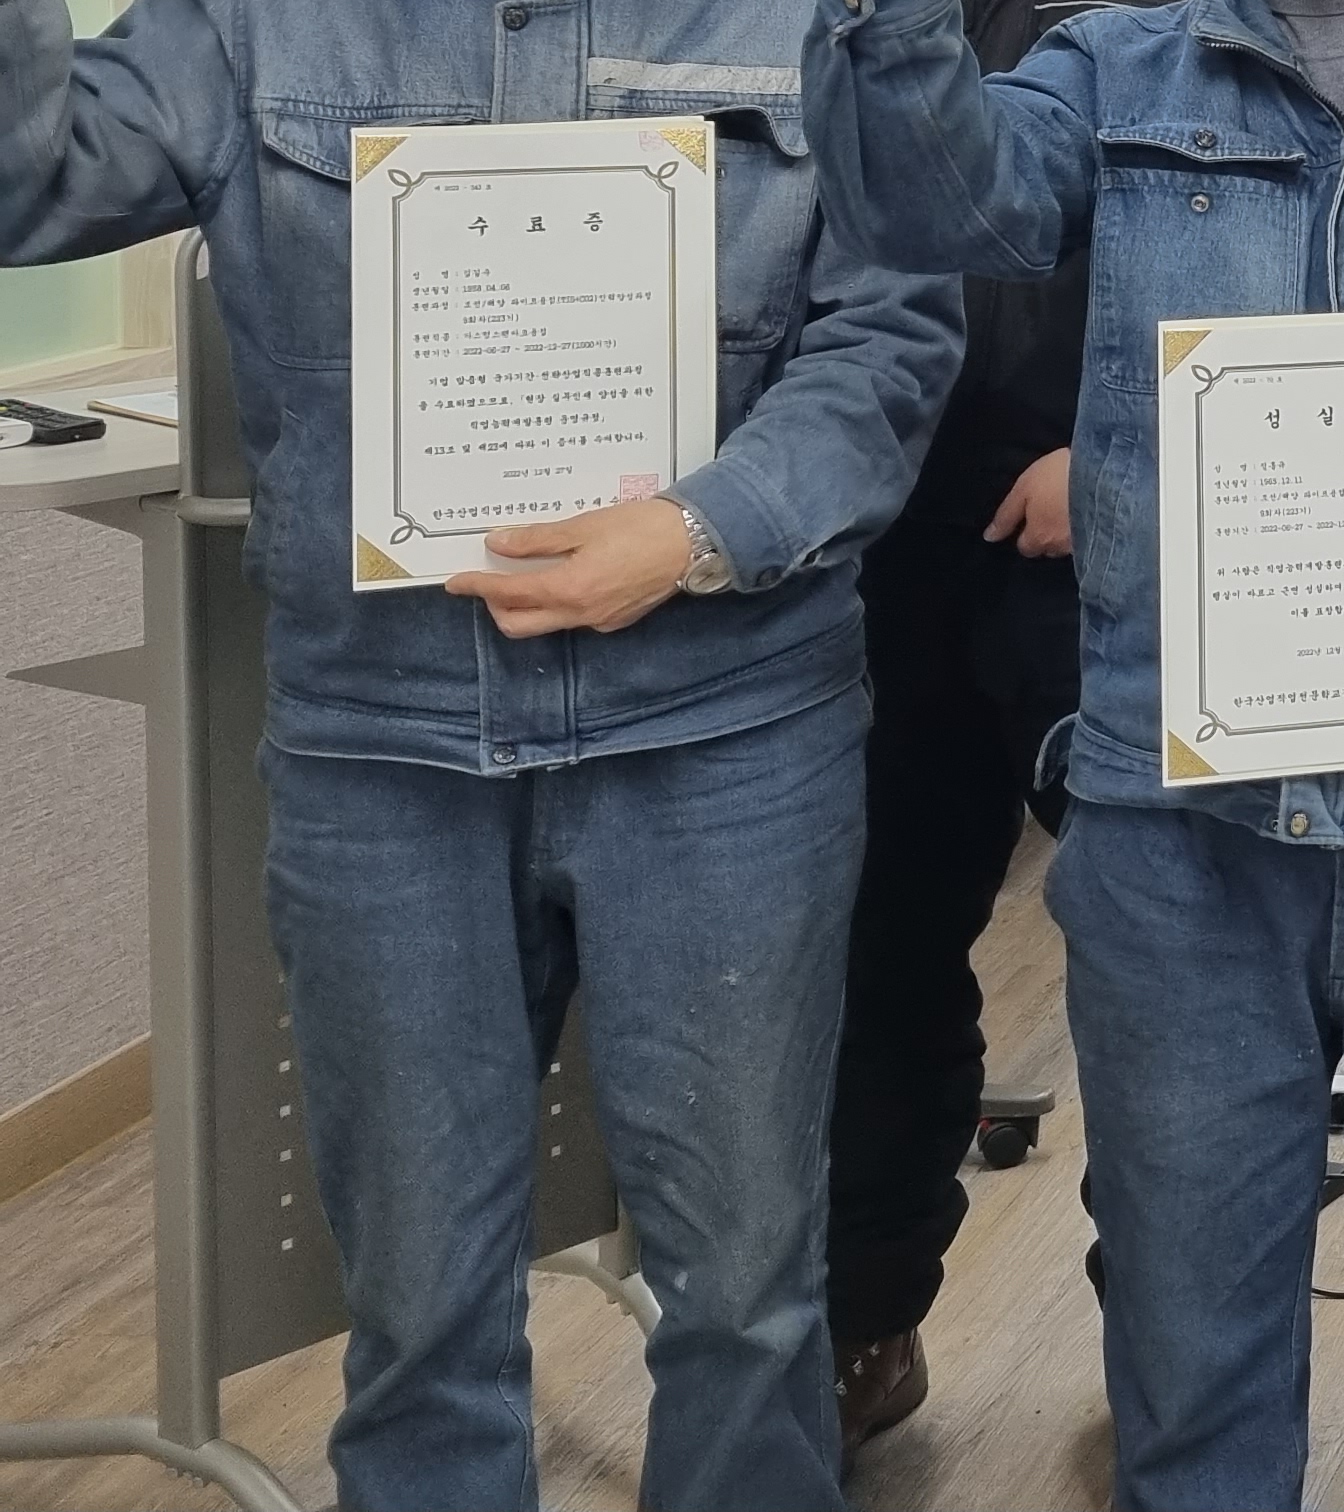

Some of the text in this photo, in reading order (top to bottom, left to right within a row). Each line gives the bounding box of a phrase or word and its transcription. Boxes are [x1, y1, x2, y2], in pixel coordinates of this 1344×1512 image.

[467, 212, 603, 236] 수 료 증
[1264, 408, 1280, 429] 성
[1317, 405, 1334, 427] 실
